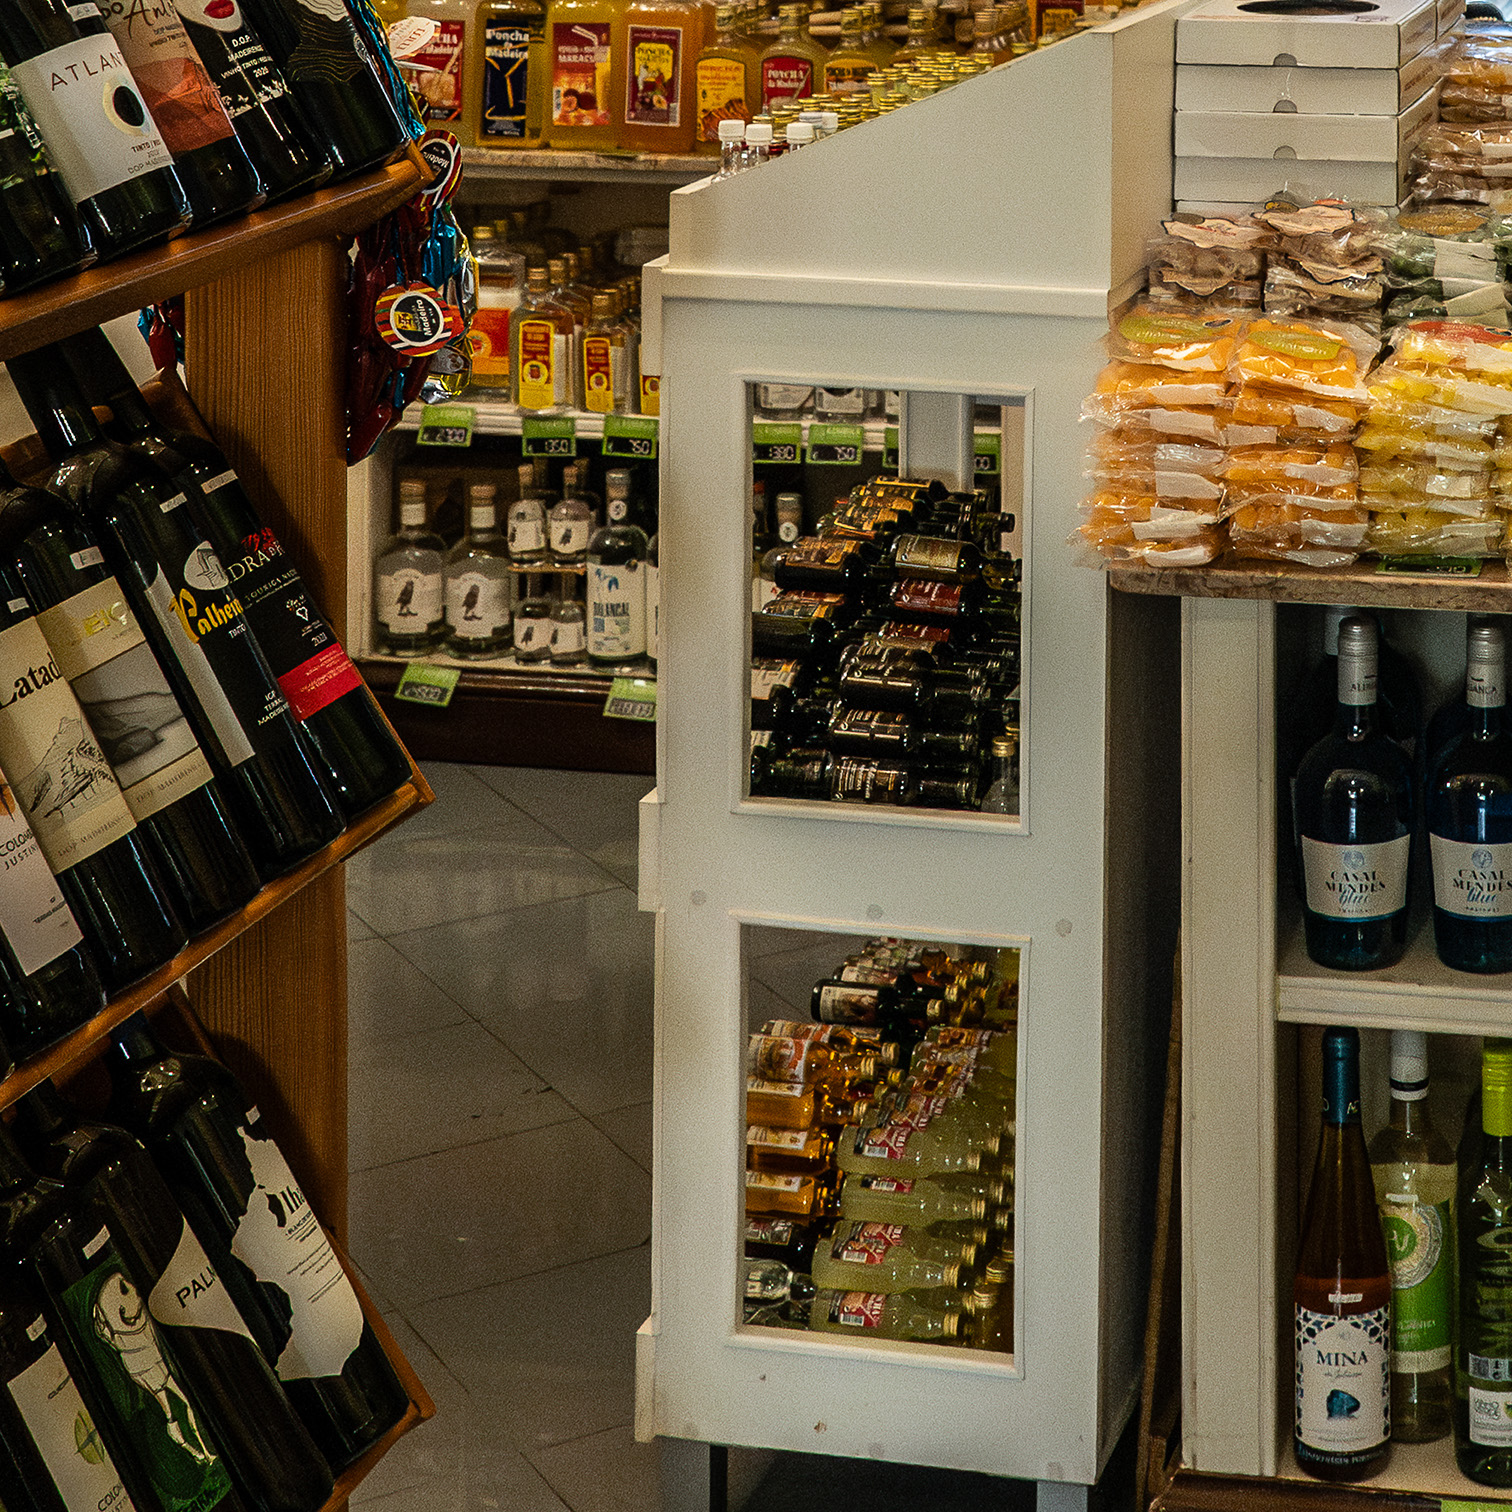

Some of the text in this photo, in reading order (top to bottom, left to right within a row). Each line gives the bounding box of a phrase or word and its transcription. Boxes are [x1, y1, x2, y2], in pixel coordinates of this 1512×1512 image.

[101, 2, 125, 20] DO
[486, 28, 530, 41] Poncha
[486, 46, 530, 60] Madeira
[768, 69, 805, 80] PONCHA
[414, 297, 432, 337] Madeira
[1330, 868, 1377, 882] CASAL
[1457, 866, 1506, 882] CASAL
[1325, 879, 1387, 893] MENDES
[1316, 1350, 1369, 1367] MINA
